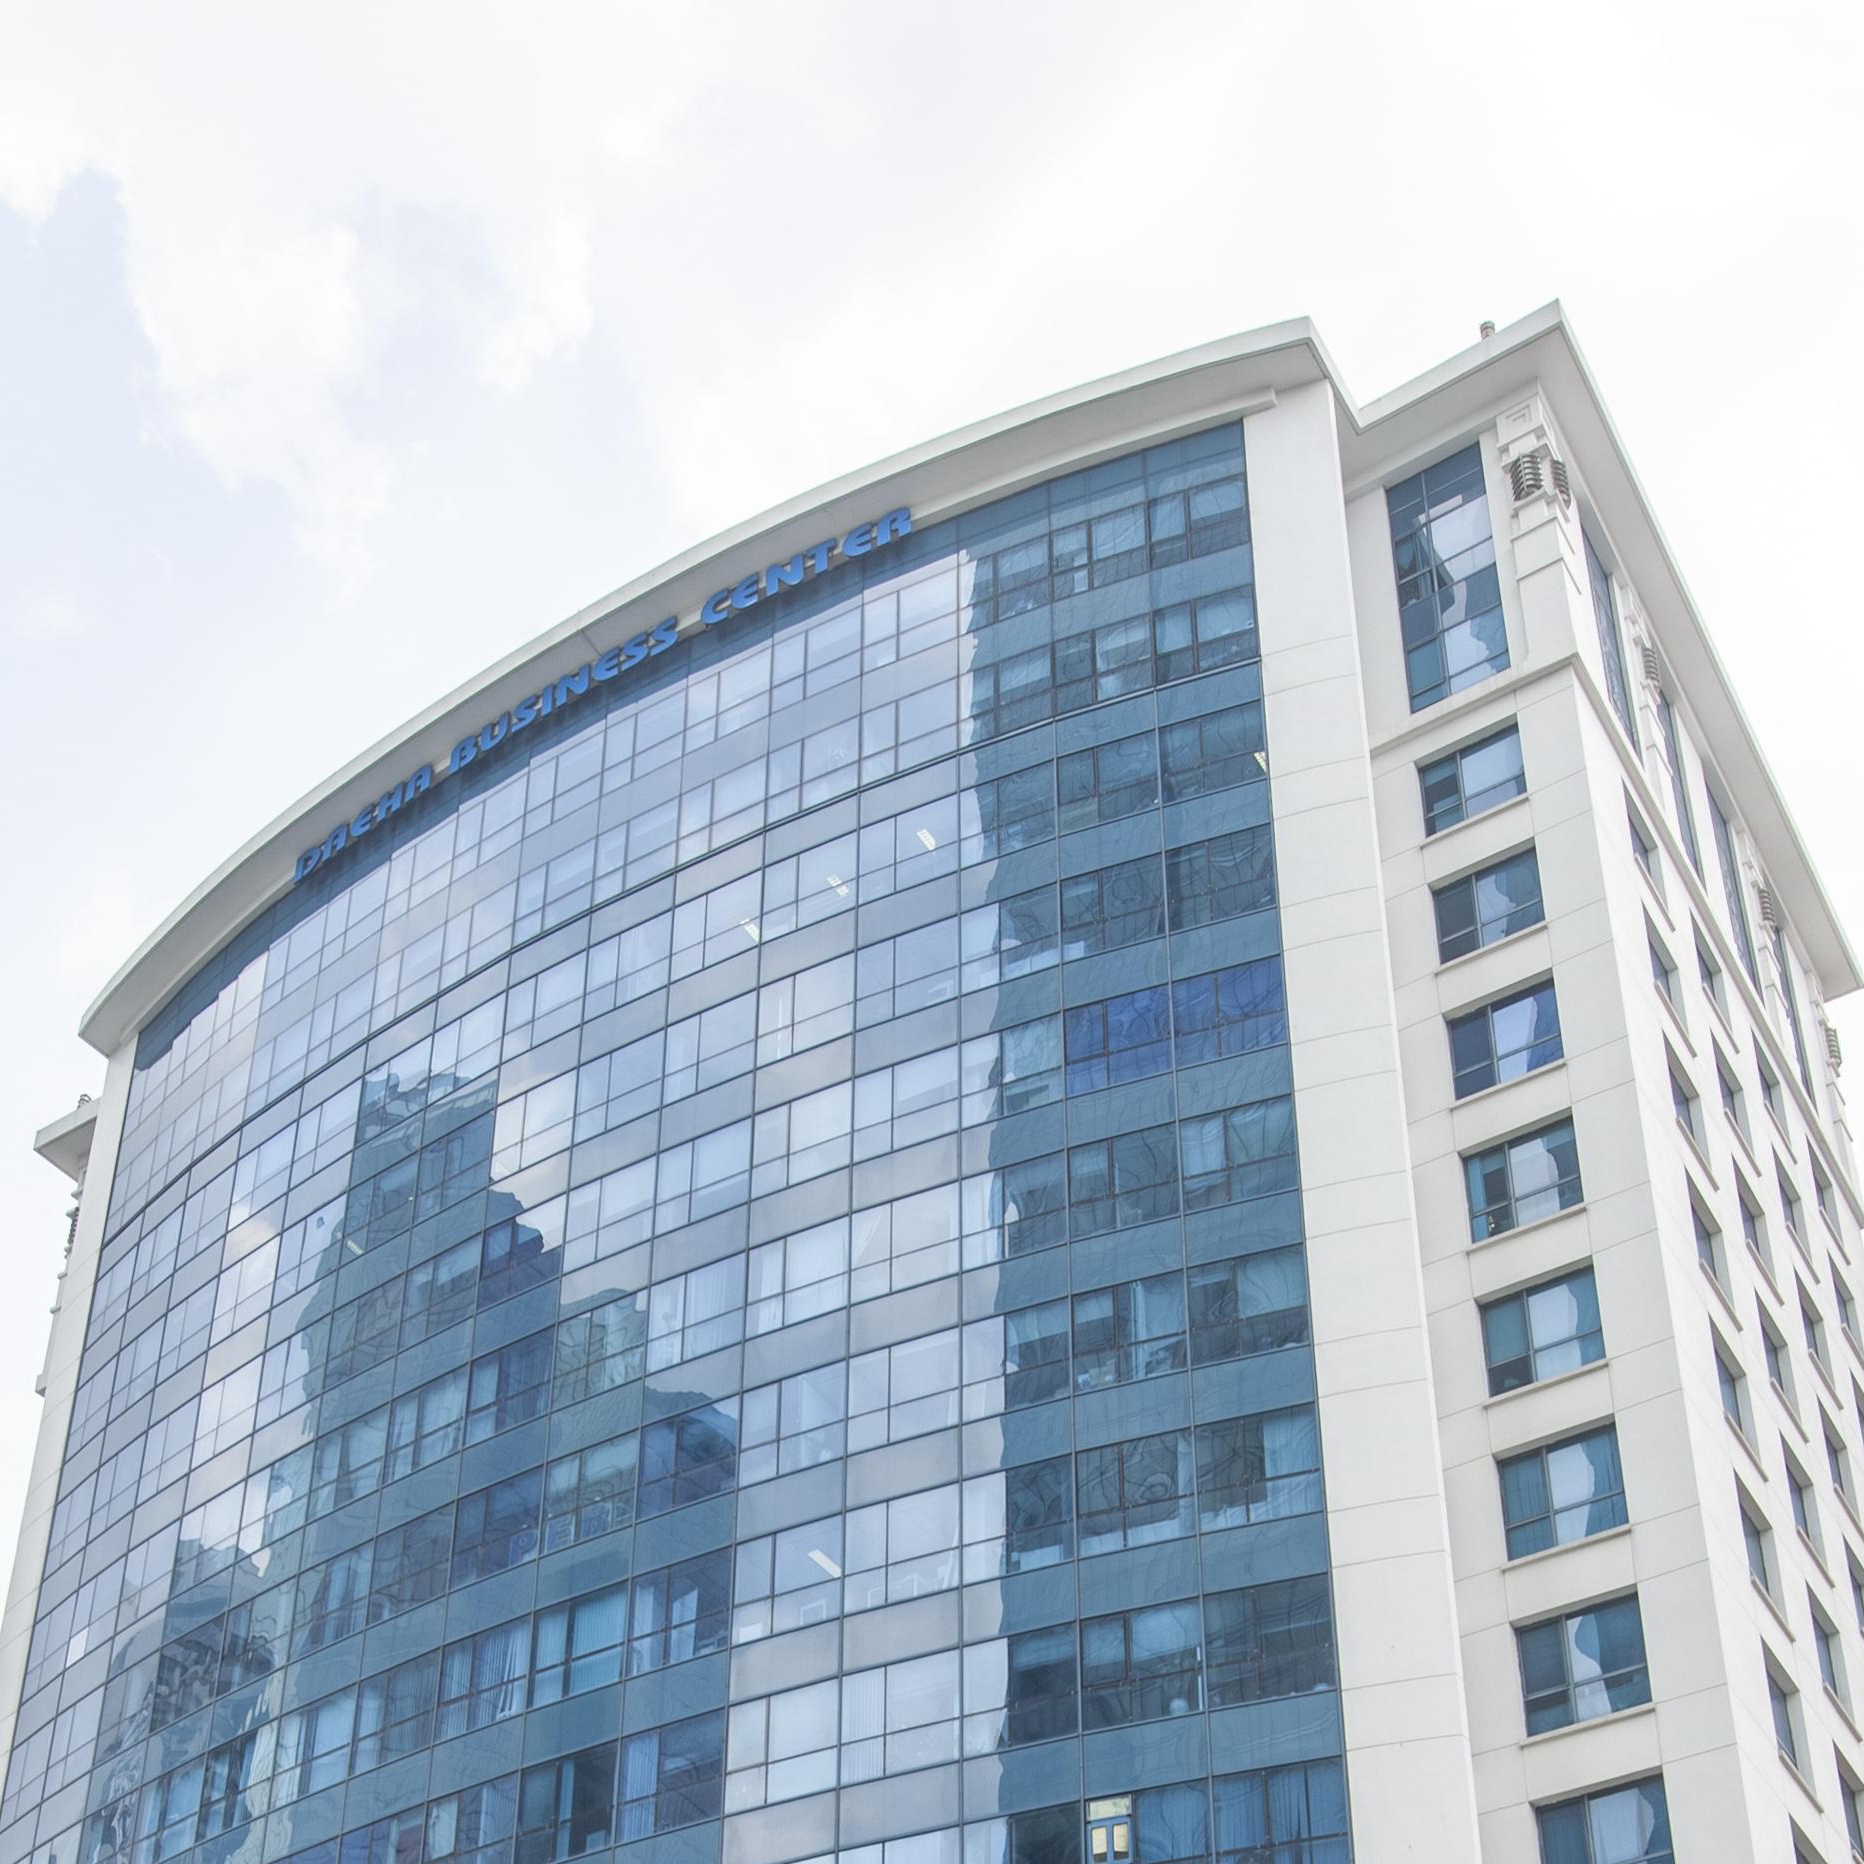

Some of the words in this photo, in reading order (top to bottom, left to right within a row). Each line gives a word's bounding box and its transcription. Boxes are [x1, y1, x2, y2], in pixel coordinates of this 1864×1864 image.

[294, 764, 433, 883] DAEHA
[448, 614, 679, 775] BUSINESS
[700, 505, 913, 626] CENTER
